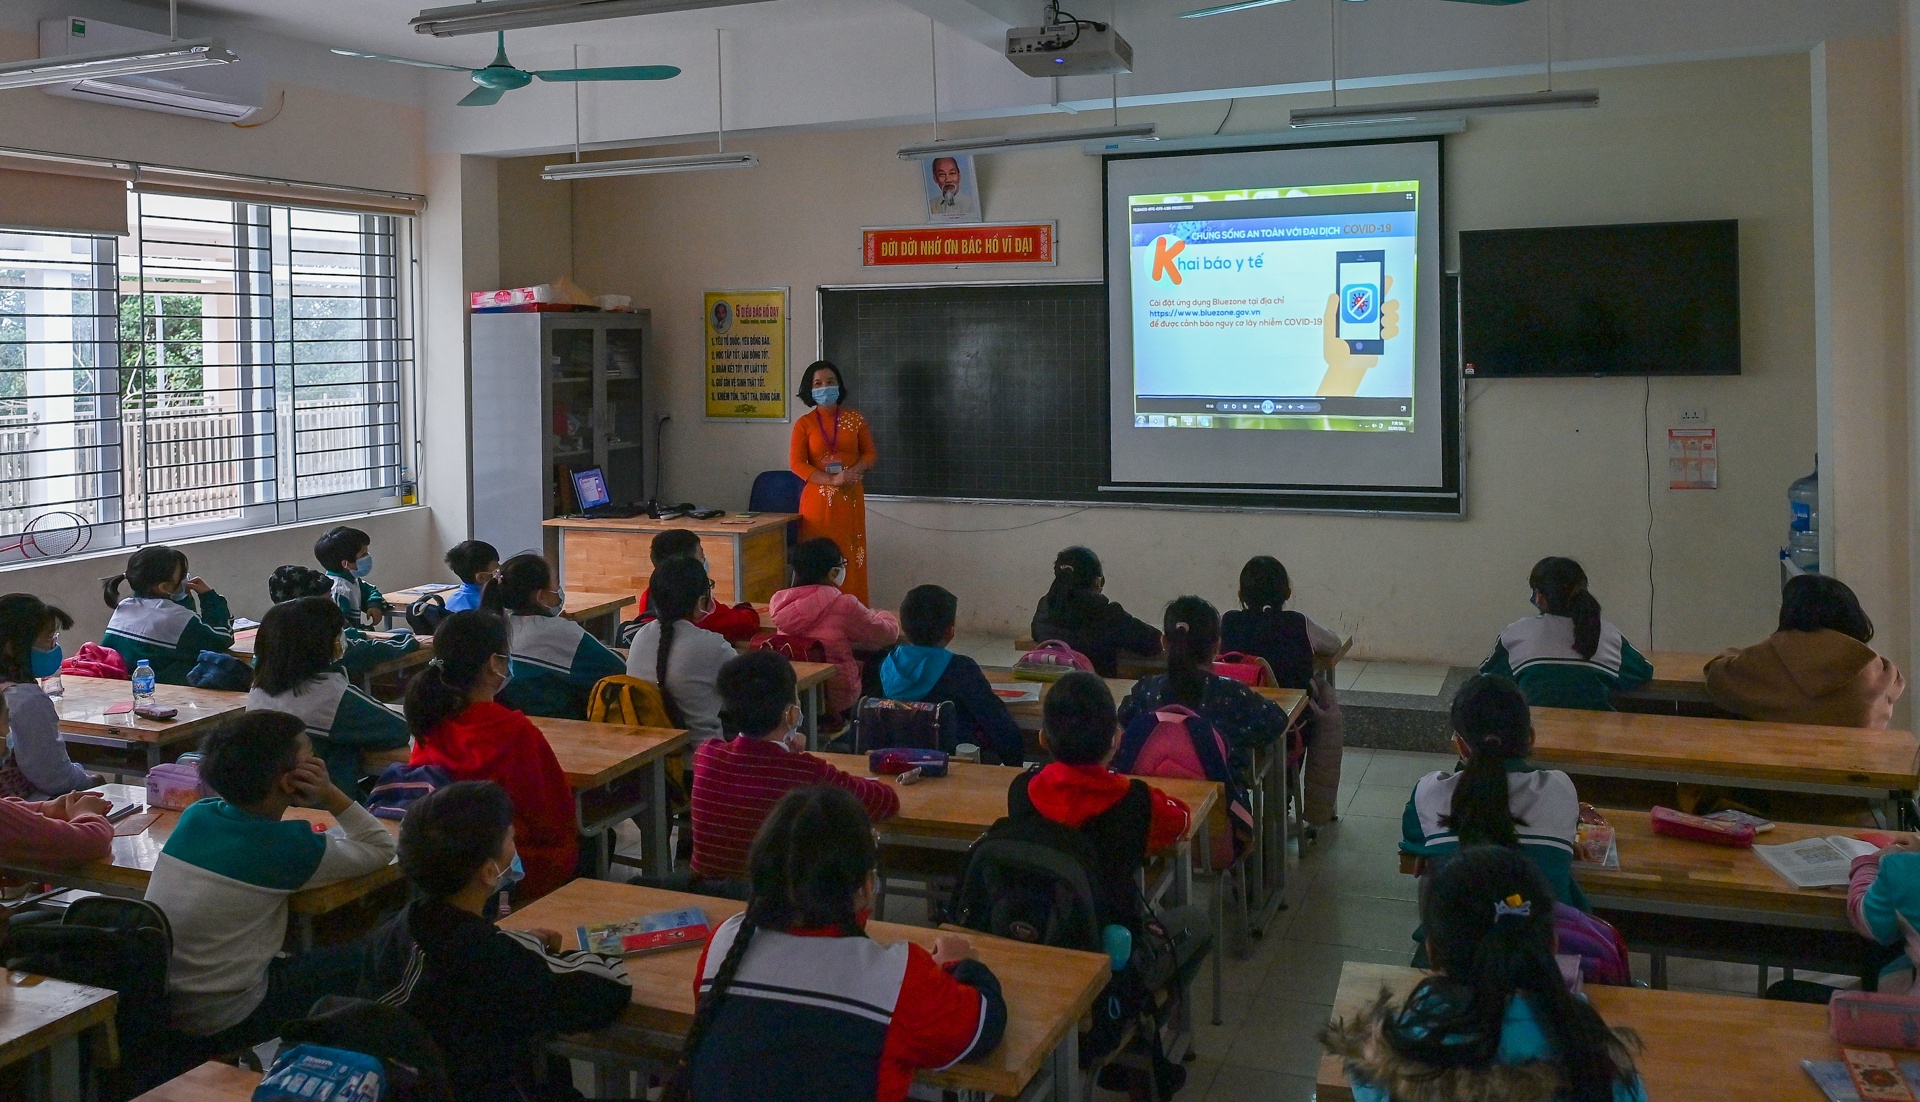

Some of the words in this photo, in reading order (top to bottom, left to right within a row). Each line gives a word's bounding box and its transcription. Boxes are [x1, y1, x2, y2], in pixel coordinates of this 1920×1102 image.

[1191, 231, 1221, 240] CHUNG
[1222, 228, 1246, 239] SỐNG
[1246, 230, 1260, 238] AN
[1260, 228, 1285, 237] TOÀN
[1285, 227, 1302, 237] VỚI
[1302, 227, 1319, 237] ĐẠI
[1319, 226, 1341, 236] DỊCH
[1343, 224, 1392, 235] COVID-19
[881, 237, 898, 257] ĐỜI
[900, 237, 917, 256] ĐỜI
[920, 235, 942, 256] NHỚ
[944, 238, 959, 255] ƠN
[961, 235, 982, 254] BÁC
[985, 233, 999, 254] HỒ
[1002, 234, 1013, 253] VĨ
[1015, 237, 1033, 256] ĐẠI
[1152, 236, 1200, 285] Khai
[1203, 256, 1231, 270] báo
[1235, 259, 1244, 272] y
[1248, 252, 1265, 268] tế
[1162, 299, 1175, 307] đặt
[1176, 299, 1191, 308] ứng
[1192, 298, 1211, 308] dụng
[1248, 297, 1258, 306] tại
[1260, 297, 1272, 306] địa
[1273, 296, 1284, 304] chỉ
[735, 304, 740, 318] 5
[1149, 309, 1261, 318] https://www.bluezone.gov.vn
[1149, 318, 1159, 327] để
[1160, 320, 1179, 328] được
[1199, 319, 1214, 327] báo
[1215, 320, 1233, 329] nguy
[1245, 319, 1257, 328] lây
[1258, 317, 1282, 326] nhiễm
[1284, 318, 1323, 326] COVID-19
